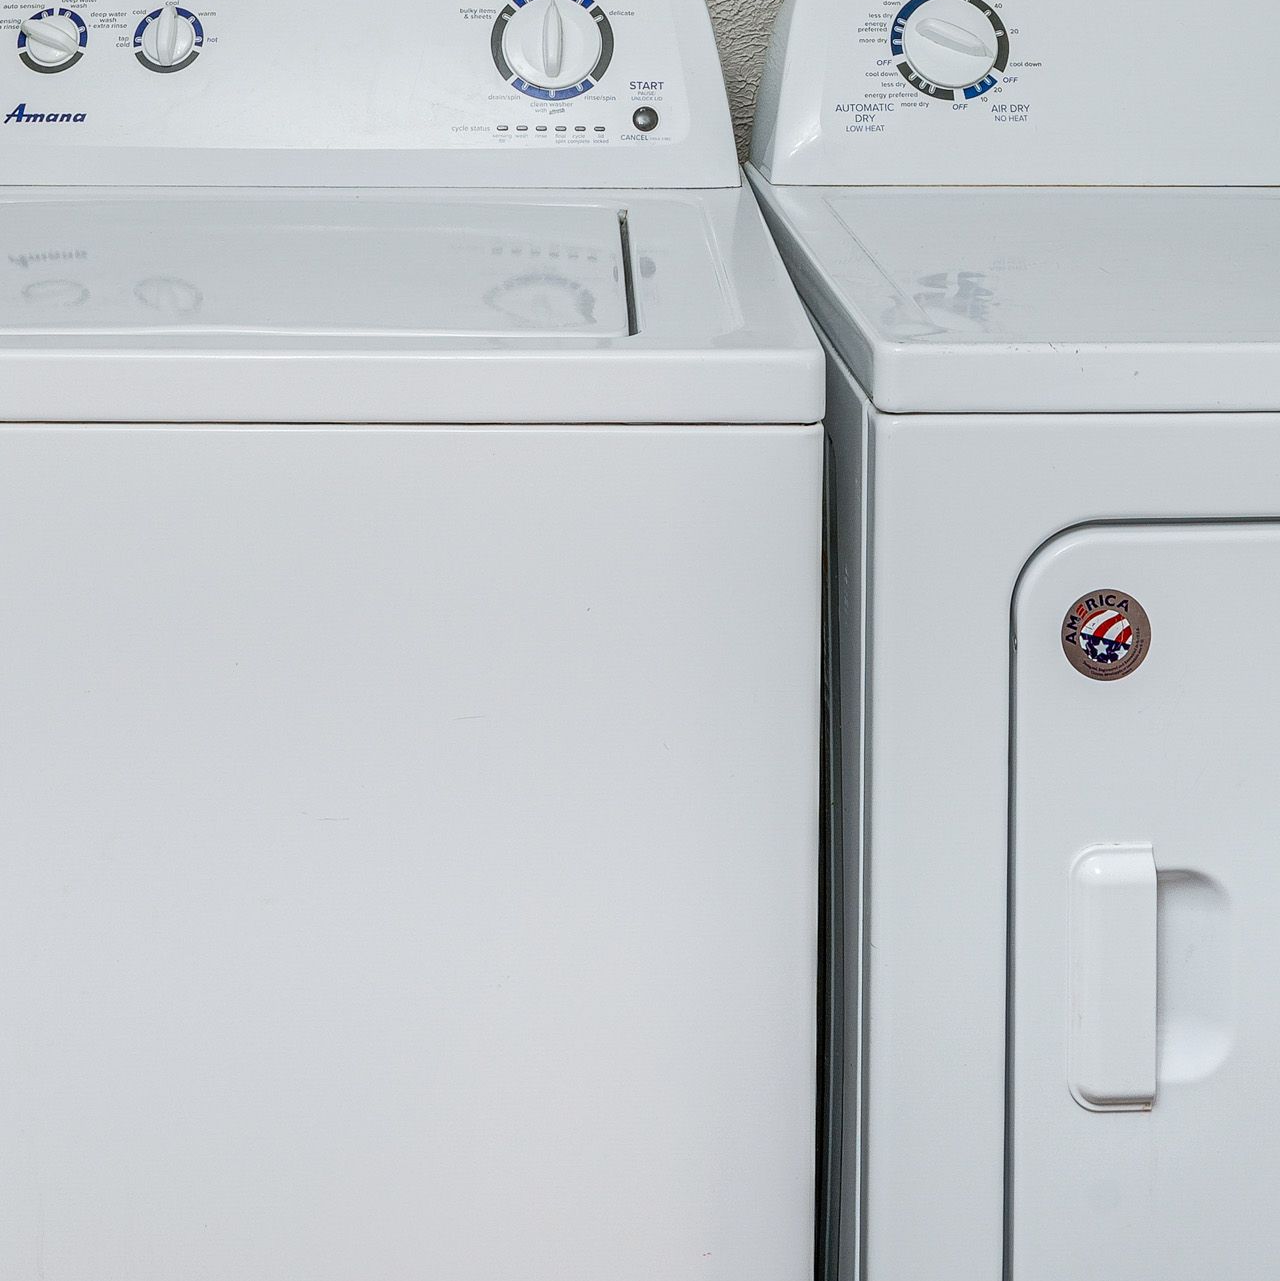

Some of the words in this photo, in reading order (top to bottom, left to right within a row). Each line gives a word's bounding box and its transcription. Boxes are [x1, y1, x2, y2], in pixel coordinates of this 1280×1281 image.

[630, 81, 664, 90] START
[835, 103, 894, 112] AUTOMATIC
[1010, 104, 1030, 112] DRY
[3, 103, 87, 124] Amana
[855, 114, 876, 122] DRY
[1065, 594, 1130, 645] AMERICA
